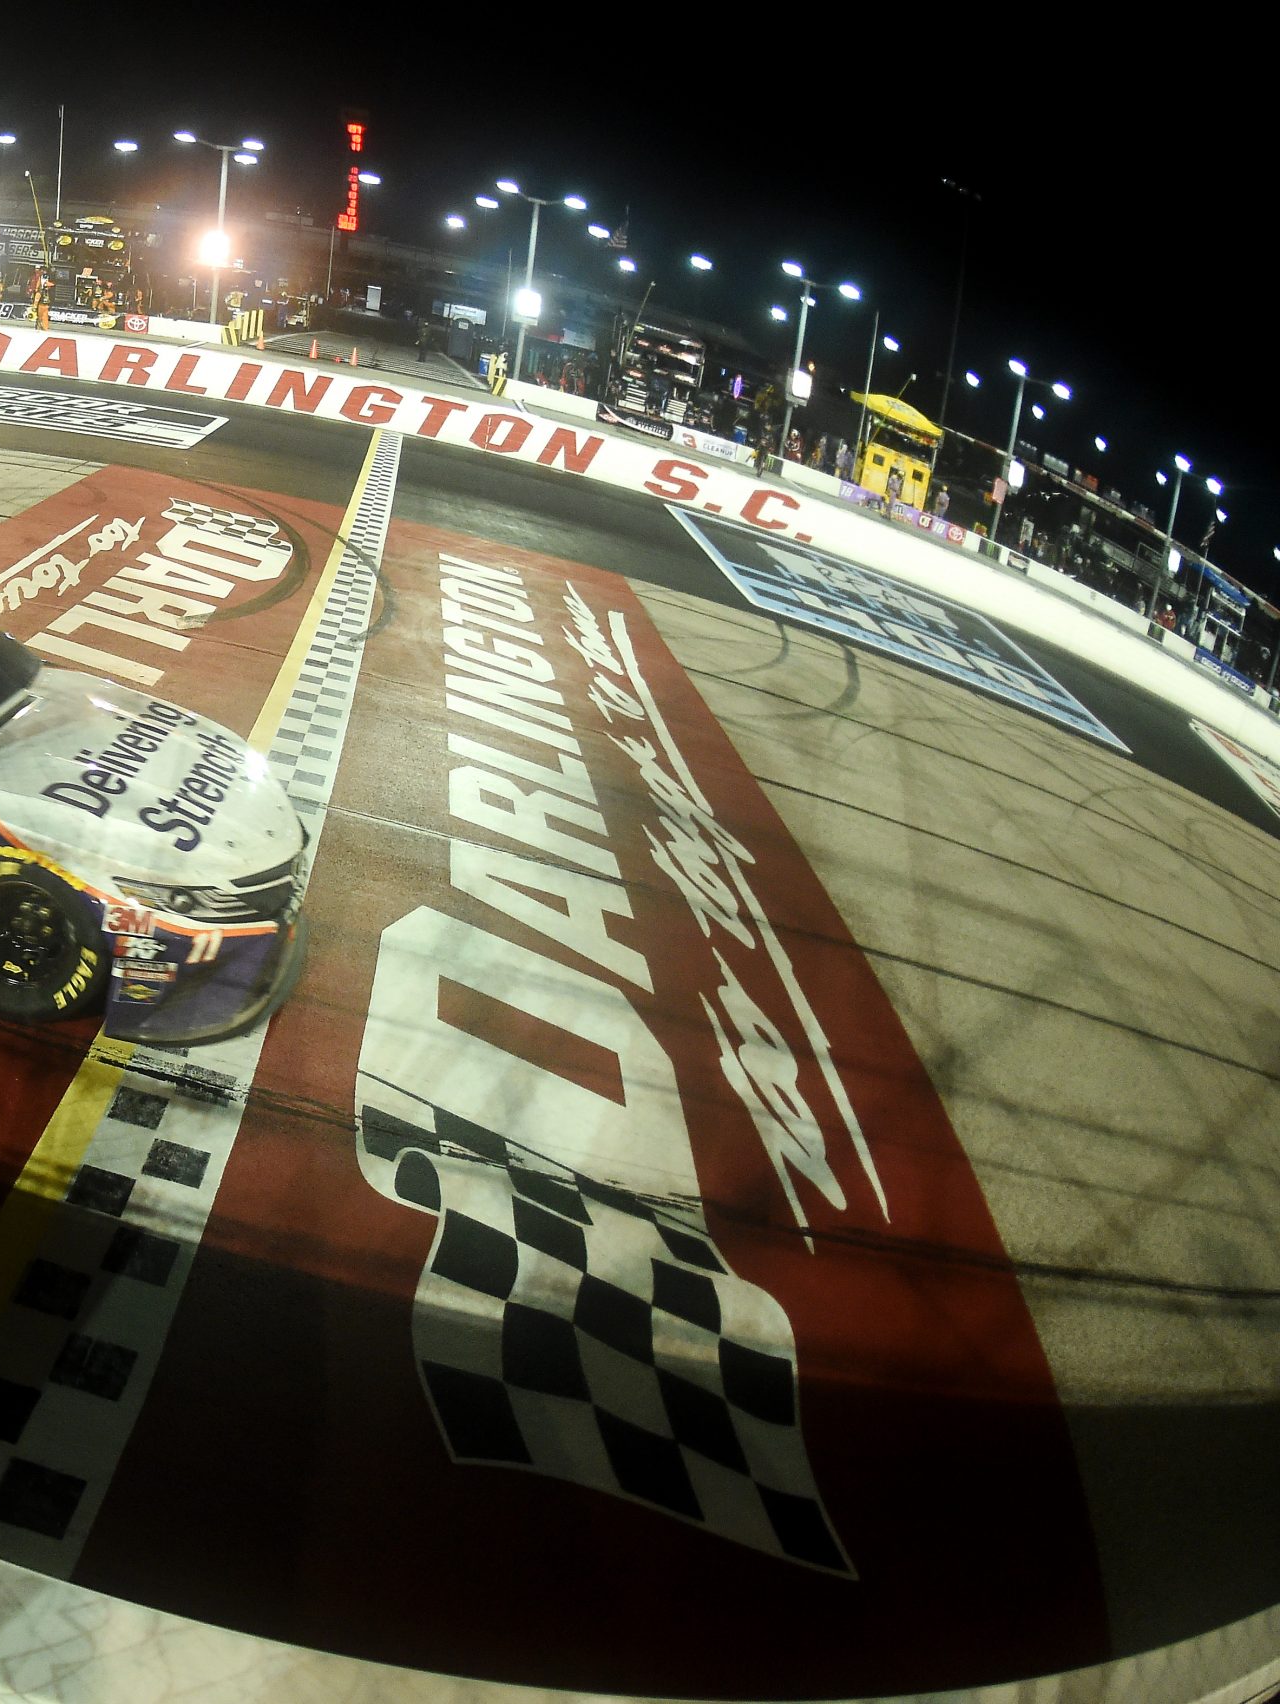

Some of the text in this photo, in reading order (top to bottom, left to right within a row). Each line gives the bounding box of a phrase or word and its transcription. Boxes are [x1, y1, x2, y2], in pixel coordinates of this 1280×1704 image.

[702, 443, 734, 458] CLEANUP
[644, 459, 813, 543] S.C.
[790, 588, 1051, 700] 400
[40, 701, 199, 818] Delivering
[139, 733, 248, 851] Strength
[107, 906, 153, 935] 3M
[355, 553, 705, 1215] DARLINGTON
[53, 946, 98, 1010] EAGLE
[184, 928, 224, 964] 11
